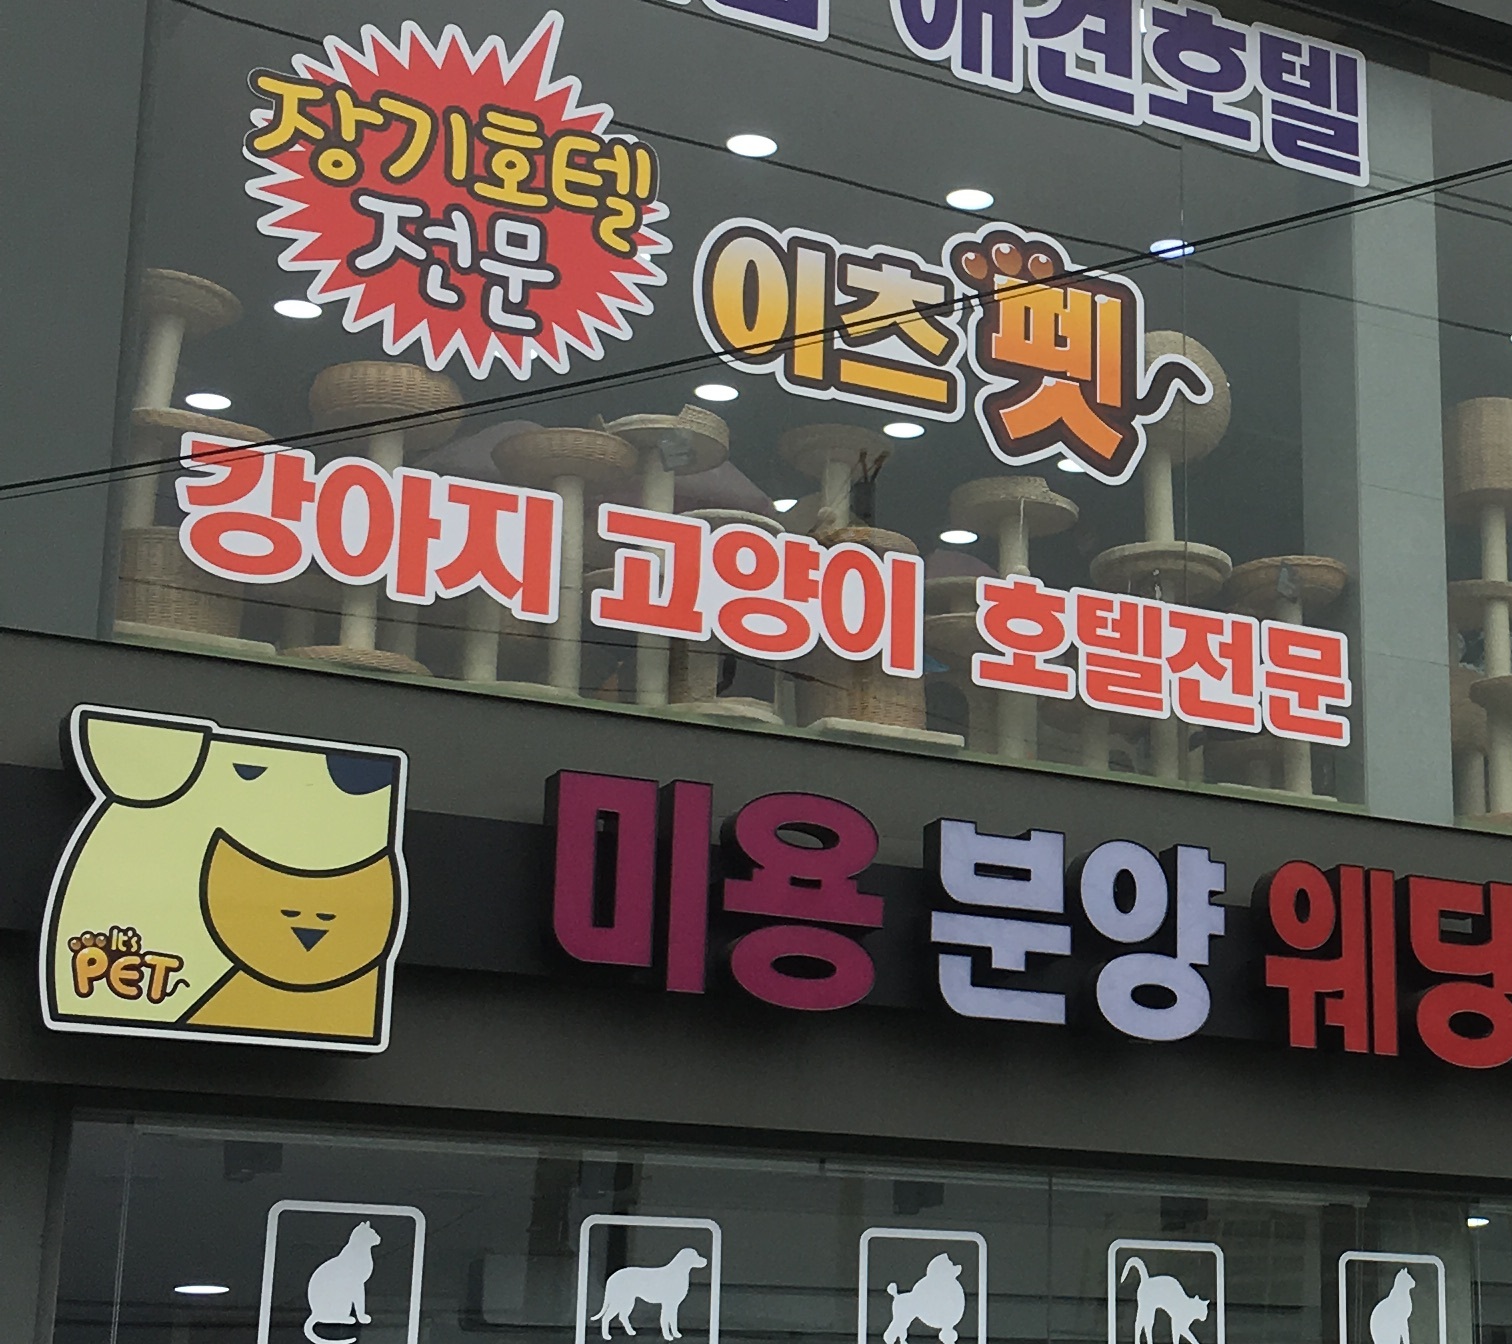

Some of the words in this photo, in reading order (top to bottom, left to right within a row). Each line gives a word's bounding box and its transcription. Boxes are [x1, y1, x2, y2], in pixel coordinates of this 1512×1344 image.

[250, 72, 654, 255] 장기호텔
[354, 194, 555, 331] 전문
[709, 234, 1126, 462] 이츠펫
[183, 437, 557, 617] 강아지
[597, 510, 918, 674] 고양이
[978, 580, 1347, 742] 호텔전문
[73, 944, 184, 1004] PET
[109, 926, 142, 953] It's
[552, 769, 884, 1012] 미용
[929, 819, 1227, 1043] 분양
